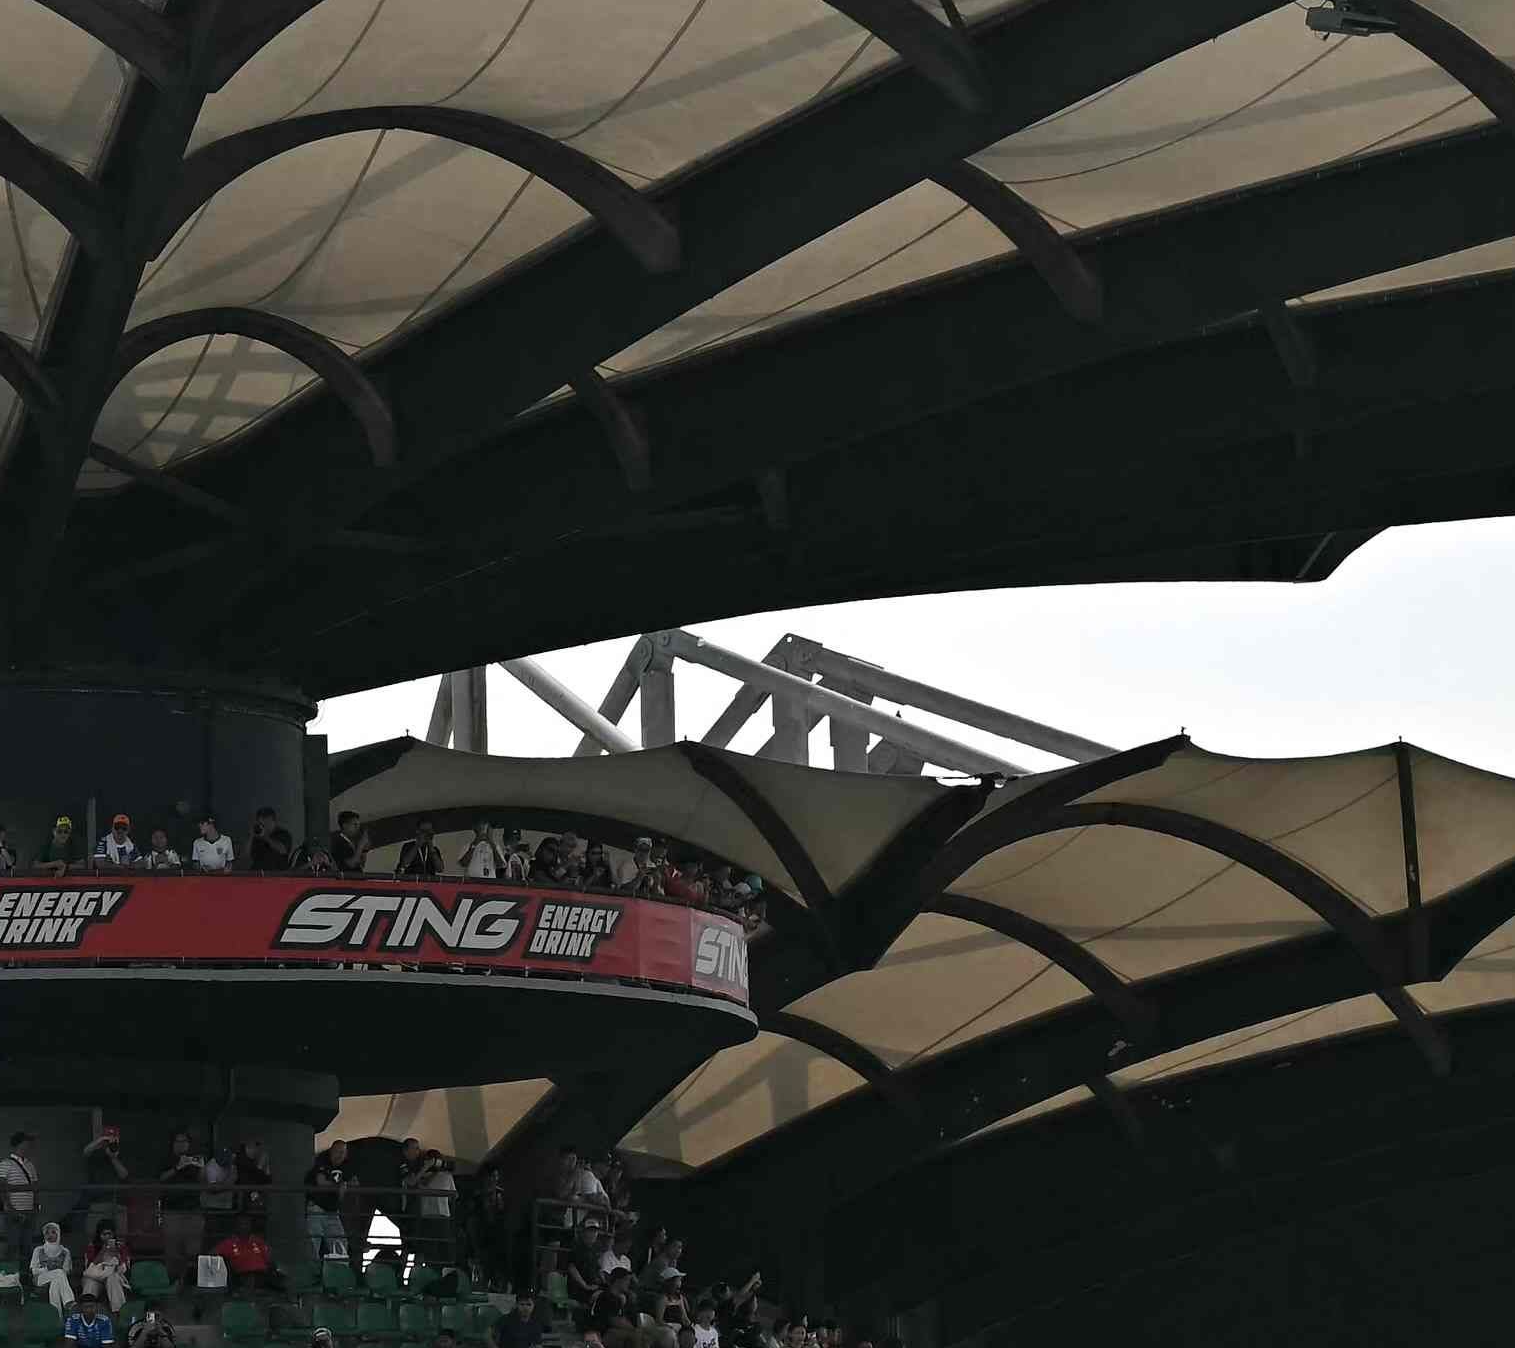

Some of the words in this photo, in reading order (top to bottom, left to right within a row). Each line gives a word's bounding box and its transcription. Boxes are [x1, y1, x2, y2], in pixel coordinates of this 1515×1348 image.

[279, 893, 521, 950] STING
[537, 903, 620, 934] ENERGY
[528, 930, 596, 958] DRINK
